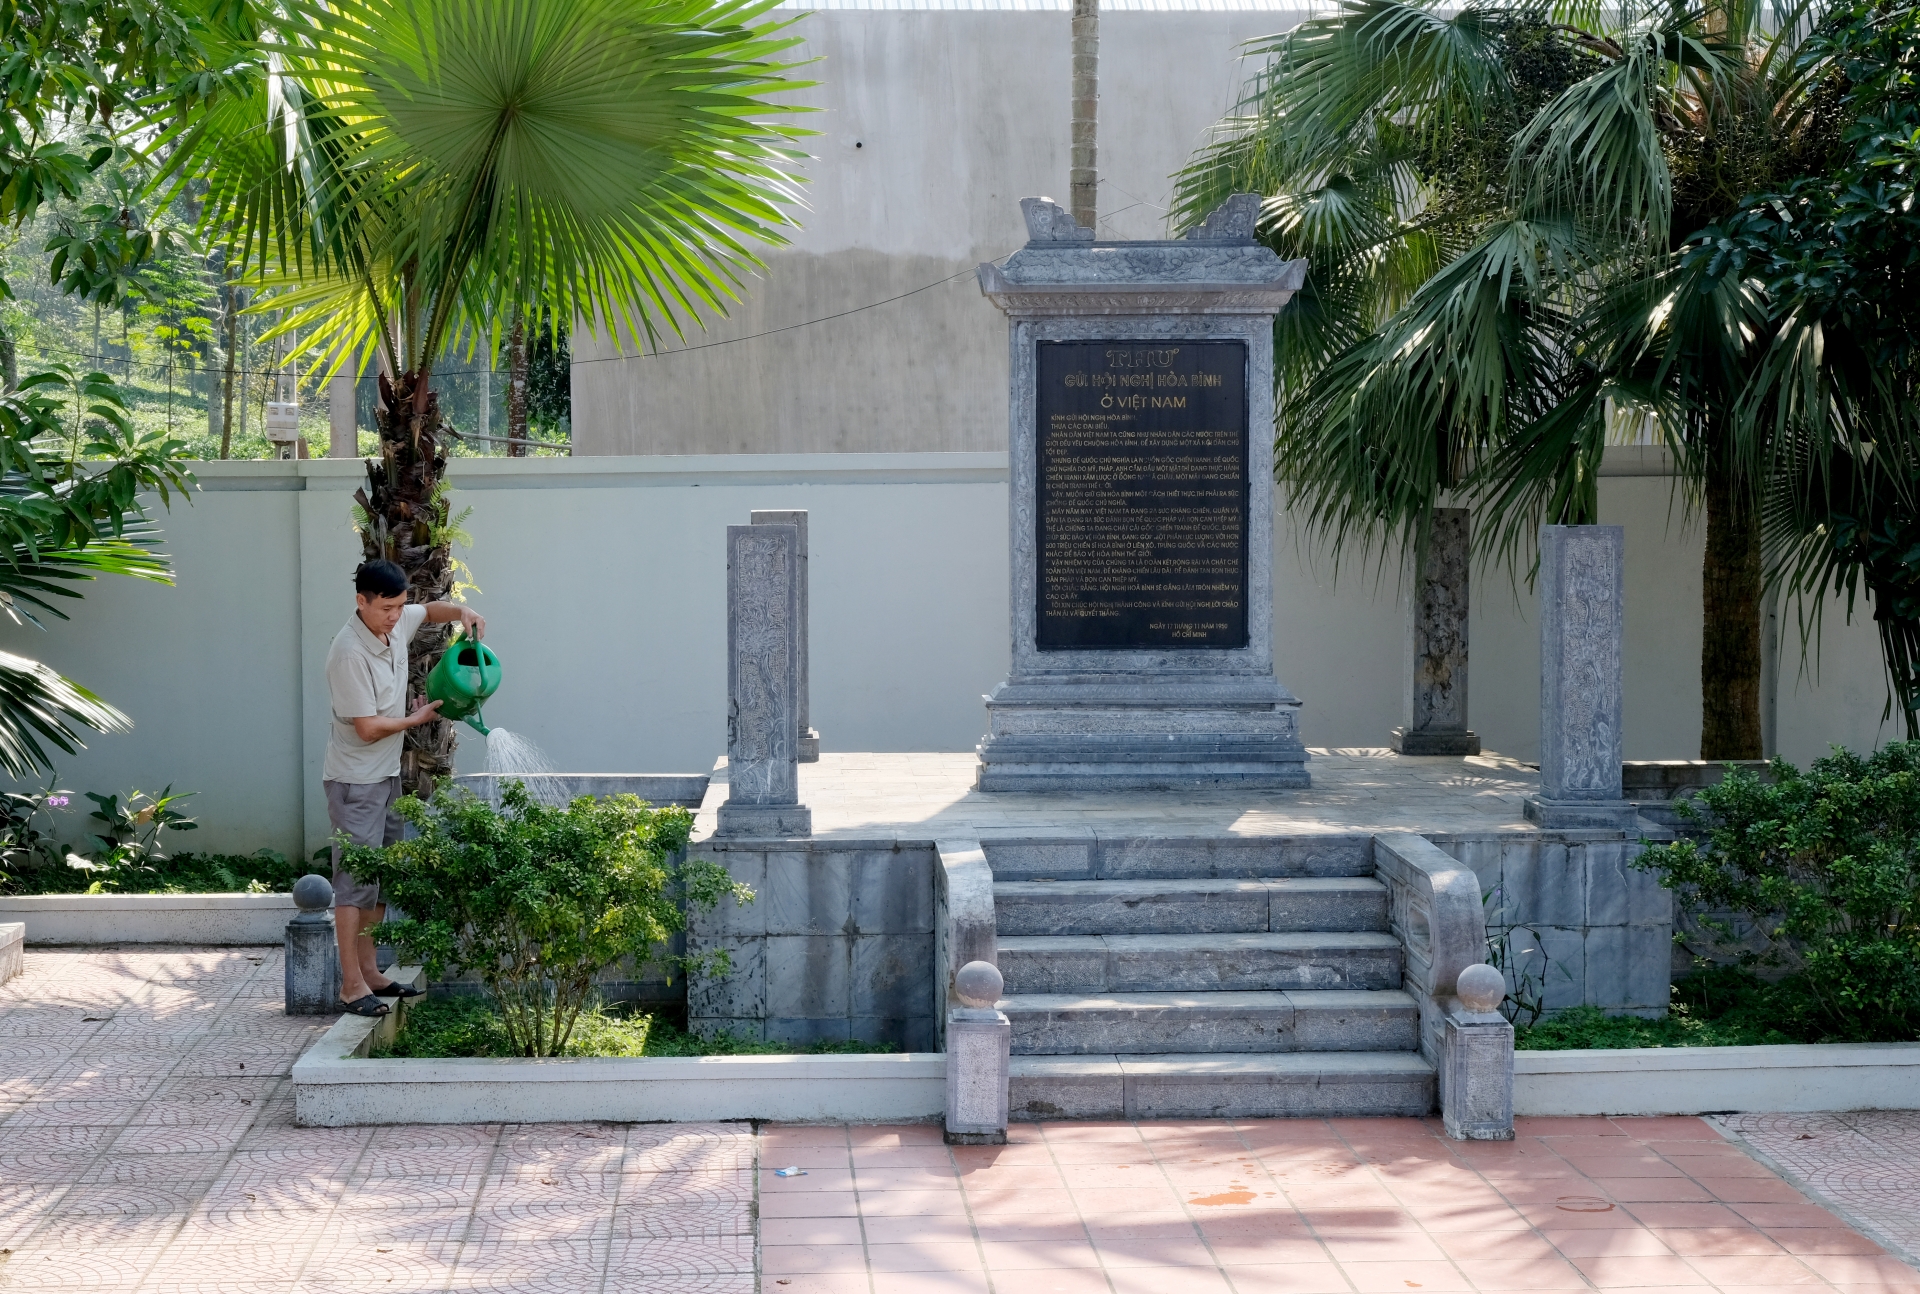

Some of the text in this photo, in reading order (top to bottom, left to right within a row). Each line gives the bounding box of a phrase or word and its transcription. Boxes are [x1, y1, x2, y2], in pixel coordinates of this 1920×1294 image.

[1106, 348, 1180, 368] THƯ
[1120, 372, 1154, 390] NGHỊ
[1158, 370, 1188, 387] HÒA
[1192, 370, 1222, 387] BÌNH
[1100, 393, 1186, 410] Ở VIỆT NAM
[1156, 464, 1168, 473] MỘT
[1211, 583, 1230, 592] NHIỆM
